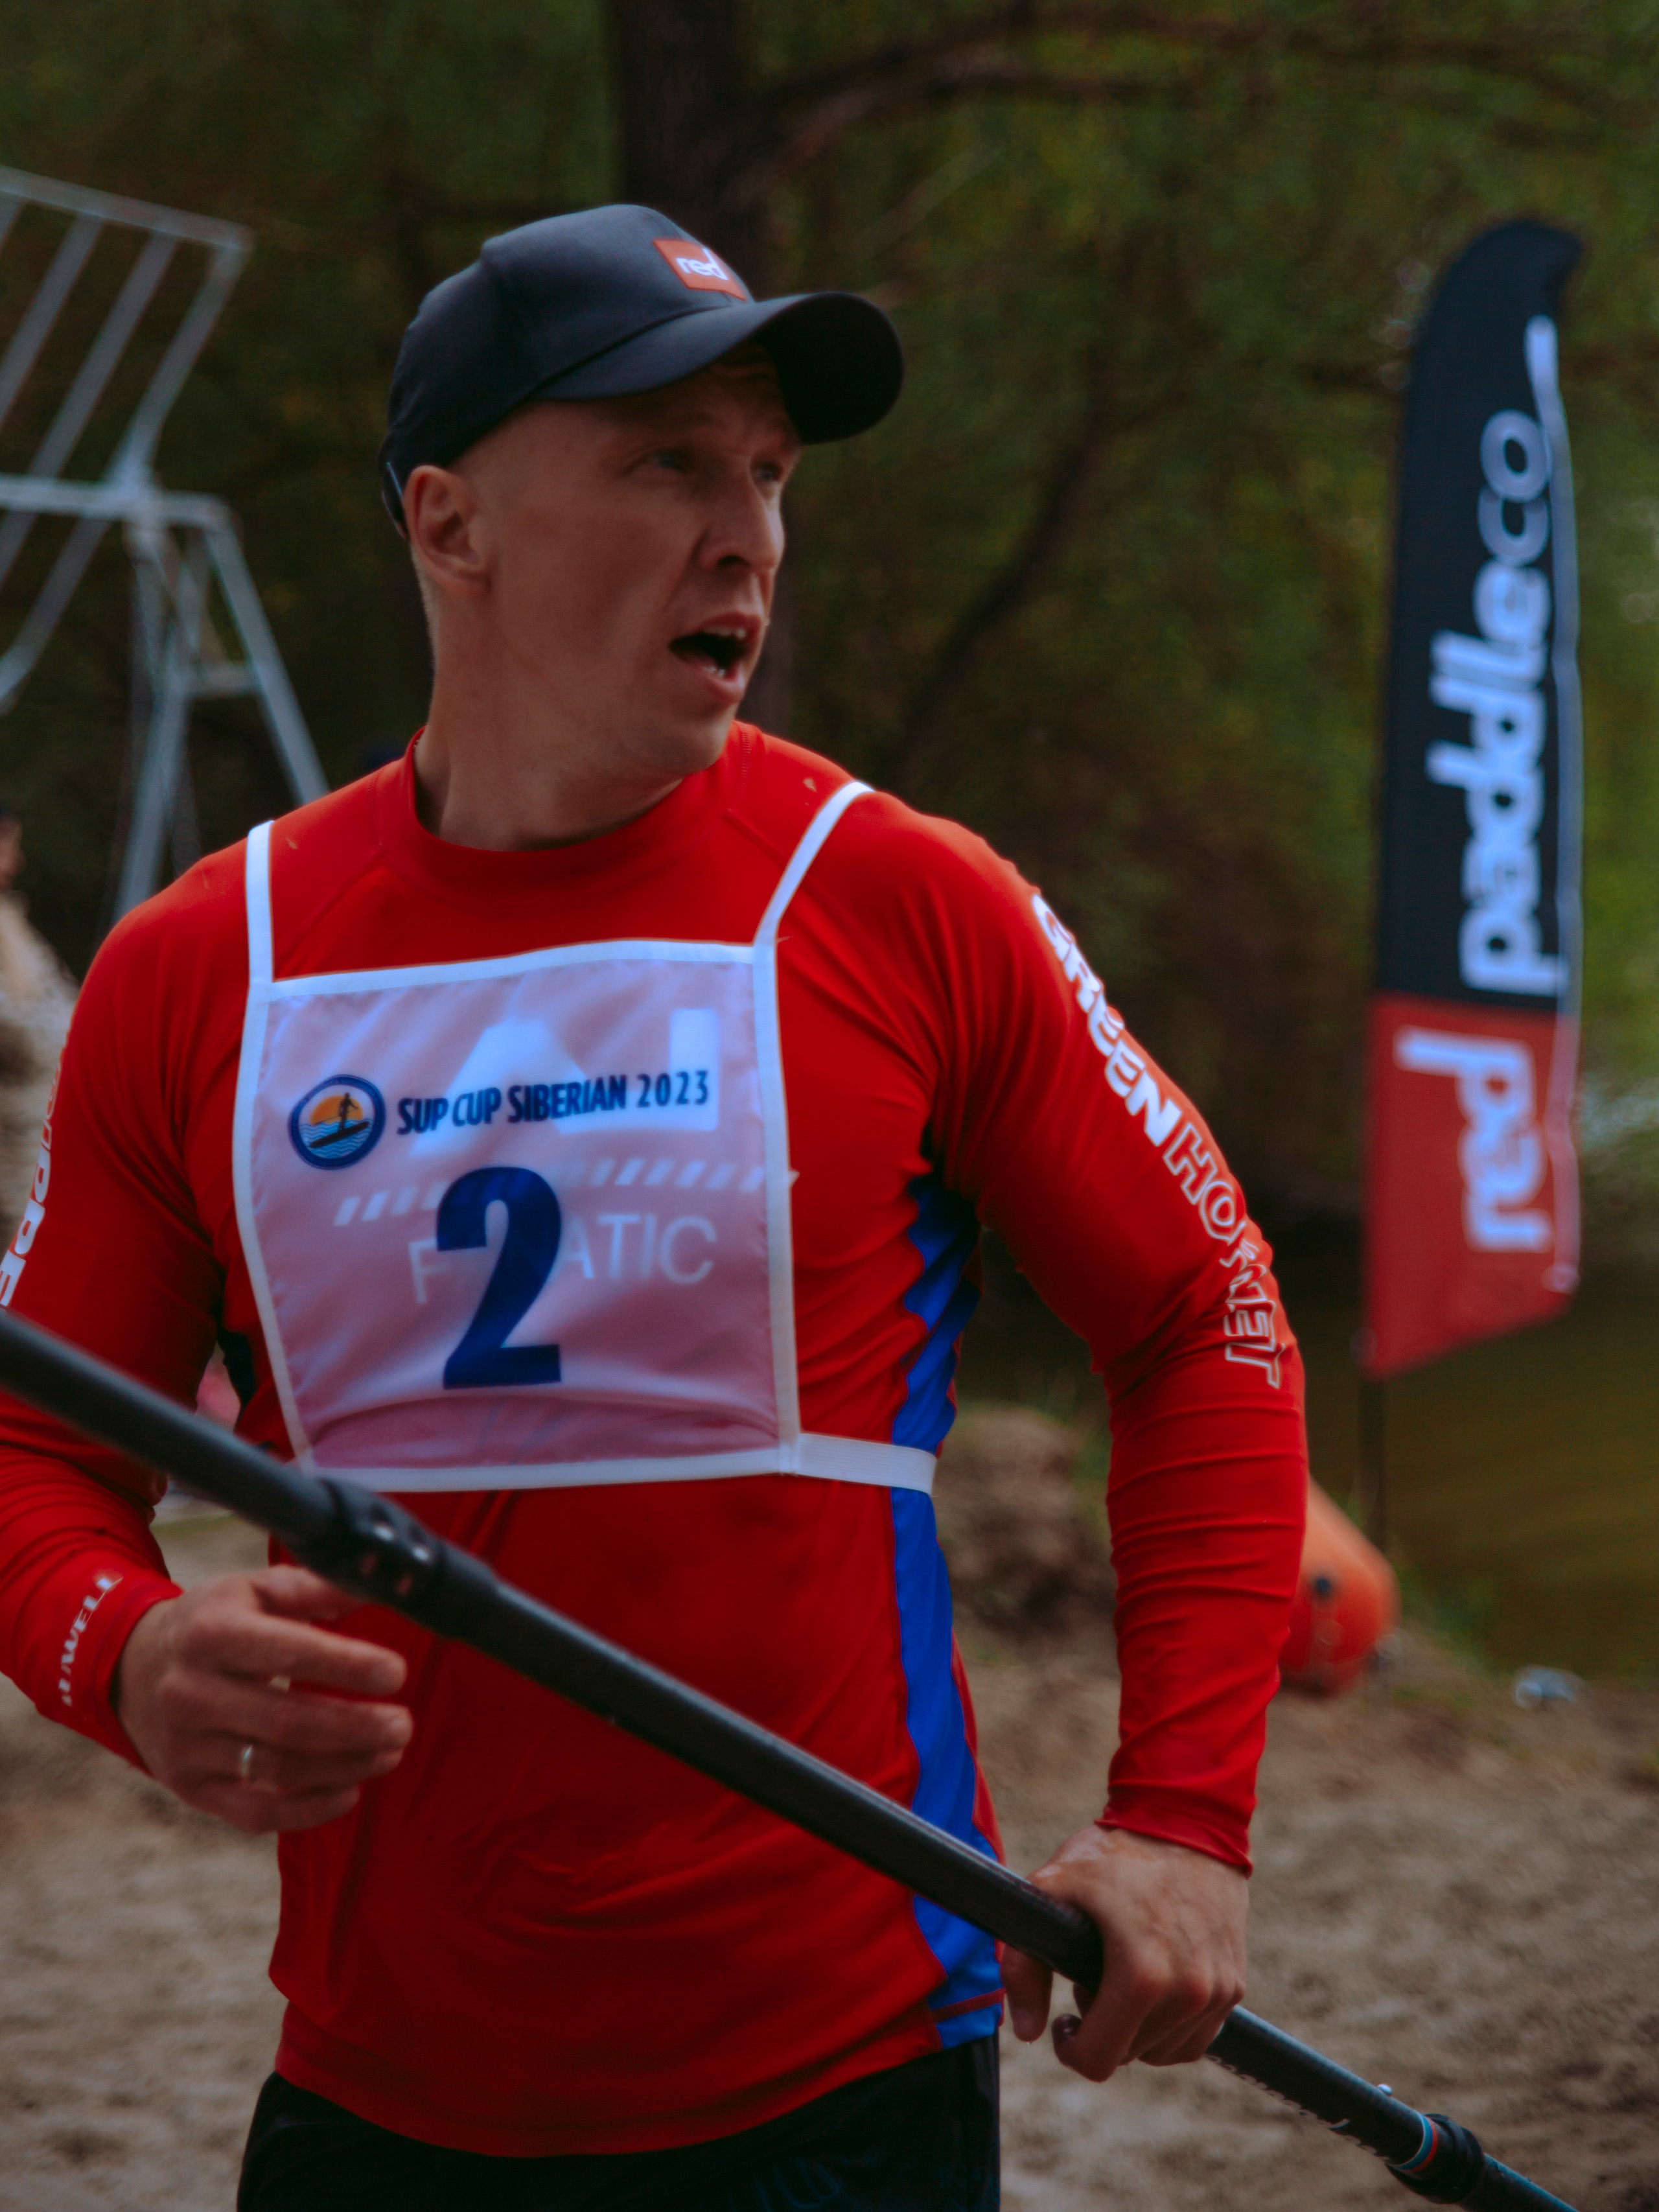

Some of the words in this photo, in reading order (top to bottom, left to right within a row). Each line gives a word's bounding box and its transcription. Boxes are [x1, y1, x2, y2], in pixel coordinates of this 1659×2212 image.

[675, 248, 729, 281] red
[396, 1097, 449, 1135] SUP
[452, 1087, 502, 1127] CUP
[507, 1074, 627, 1124] SIBERIAN
[637, 1069, 709, 1108] 2023
[1395, 1025, 1553, 1252] red
[408, 1210, 717, 1305] FATIC
[436, 1166, 562, 1390] 2
